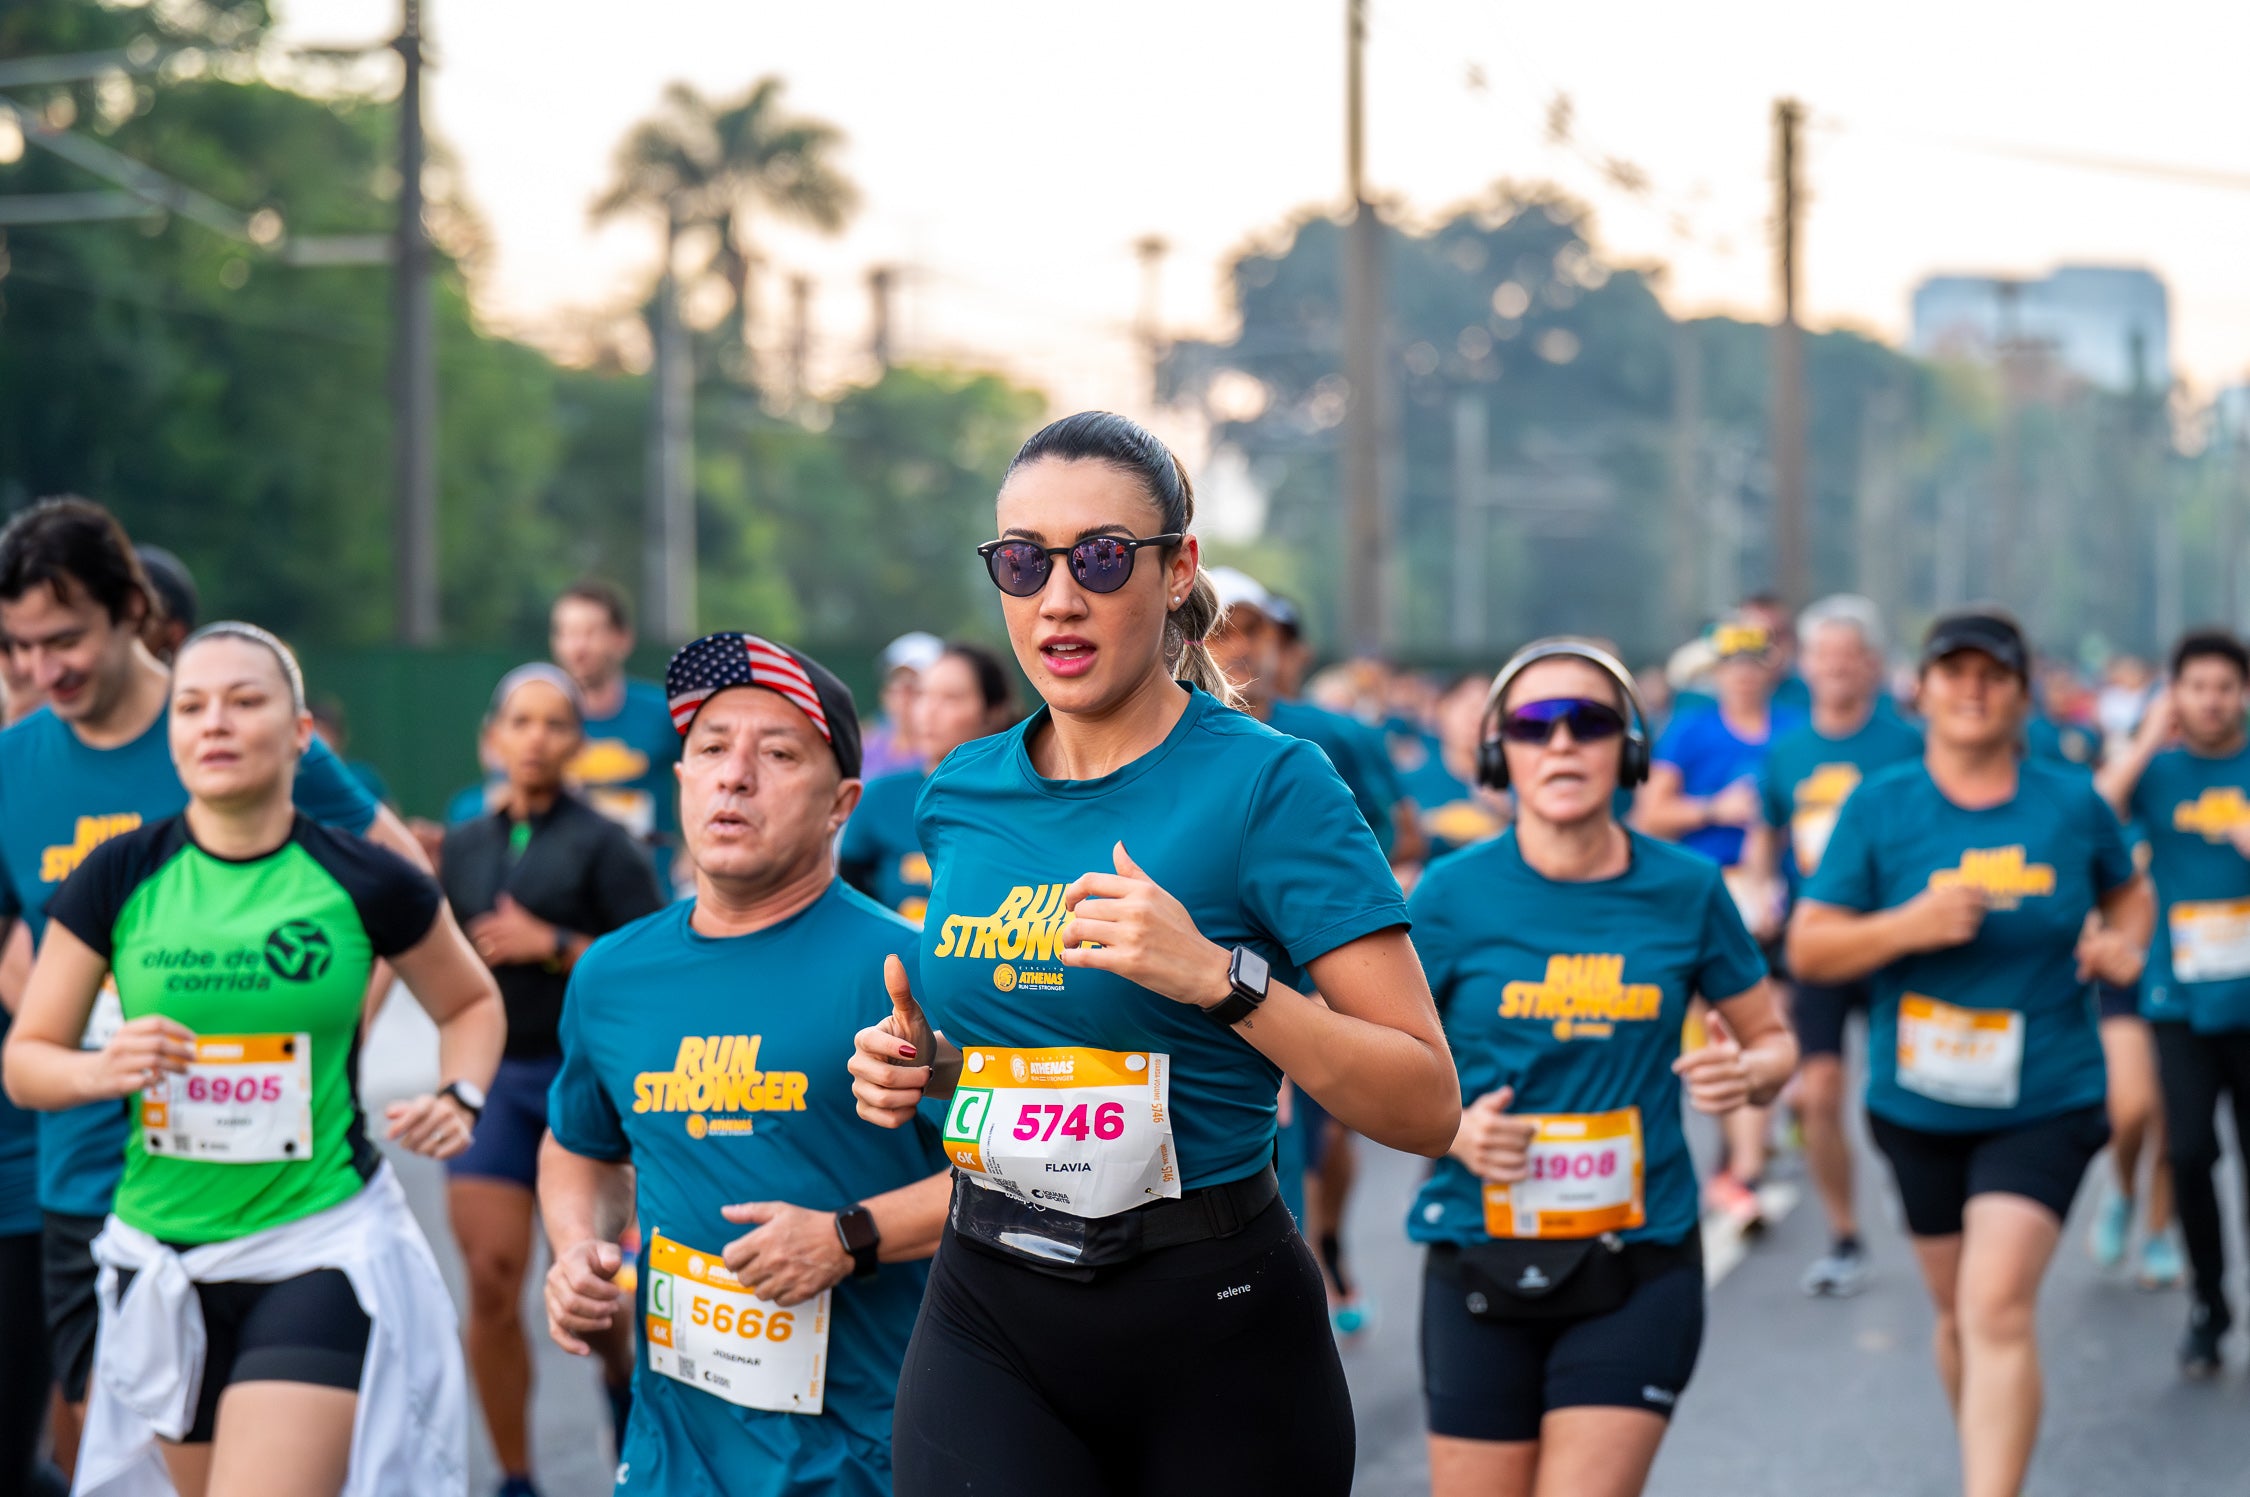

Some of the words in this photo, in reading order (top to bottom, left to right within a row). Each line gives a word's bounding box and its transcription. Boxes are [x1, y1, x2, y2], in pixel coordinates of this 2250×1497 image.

[143, 948, 216, 969] clube
[224, 949, 260, 969] de
[166, 973, 271, 992] corrida
[1018, 971, 1064, 985] ATHENAS
[673, 1034, 762, 1075] RUN
[1030, 1060, 1075, 1075] ATHENAS
[188, 1075, 282, 1104] 6905
[632, 1071, 808, 1114] STRONGER
[956, 1096, 979, 1134] C
[1013, 1102, 1124, 1141] 5746
[956, 1151, 976, 1165] 6K
[1045, 1162, 1092, 1173] FLAVIA
[654, 1279, 665, 1311] C
[1217, 1284, 1251, 1300] selene
[691, 1296, 795, 1342] 5666
